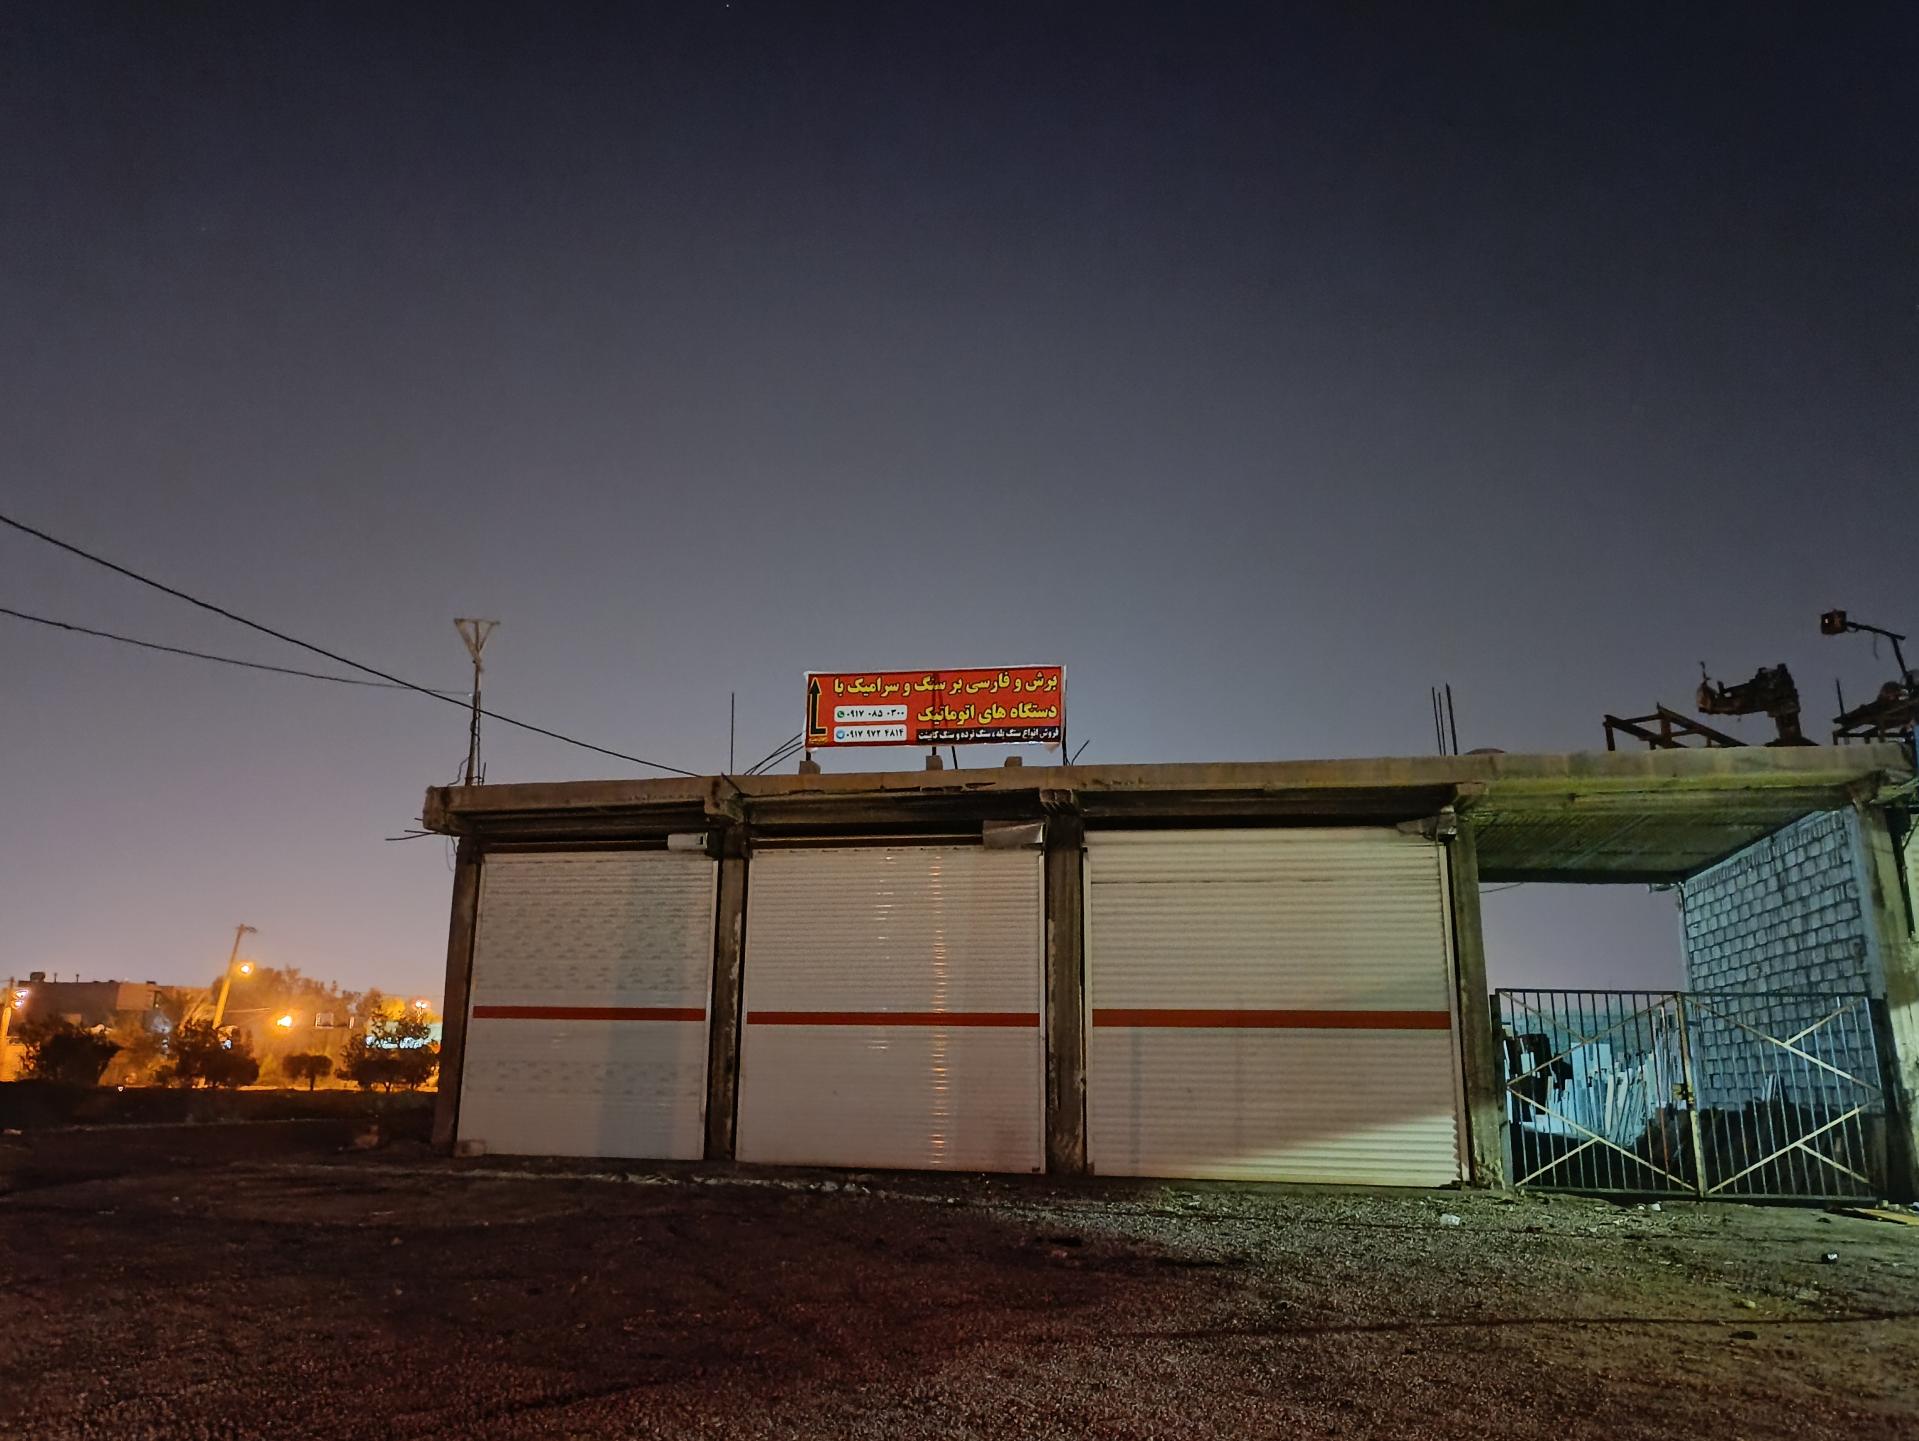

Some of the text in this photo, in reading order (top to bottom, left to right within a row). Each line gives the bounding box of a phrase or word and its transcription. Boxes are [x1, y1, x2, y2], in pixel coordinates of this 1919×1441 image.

[833, 678, 844, 697] با
[847, 677, 899, 697] سرامیک
[903, 683, 911, 696] و
[966, 671, 1010, 693] فارسی
[1014, 680, 1021, 692] و
[1025, 672, 1057, 692] برش
[917, 701, 1057, 726] دستگاه های اتوماتیک
